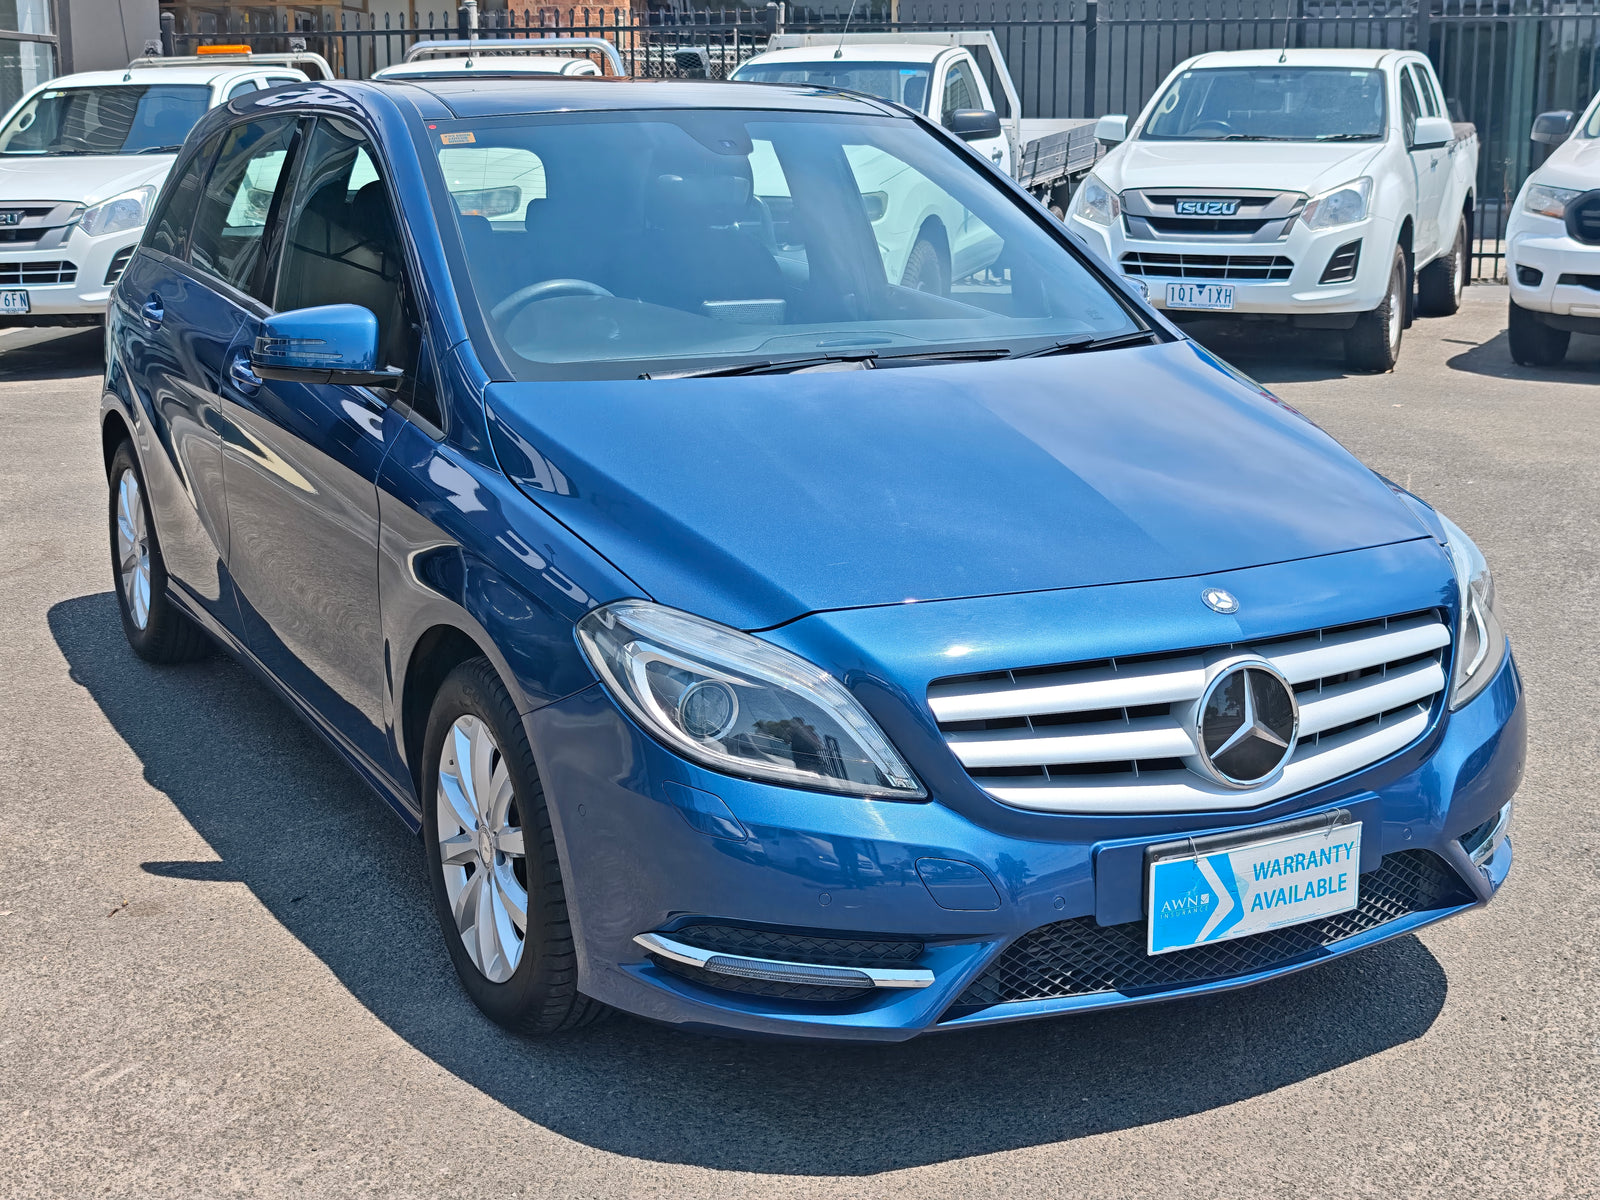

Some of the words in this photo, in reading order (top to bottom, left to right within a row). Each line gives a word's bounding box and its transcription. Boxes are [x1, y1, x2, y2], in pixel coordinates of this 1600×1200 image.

[1177, 202, 1236, 214] ISUZU
[4, 292, 27, 307] 6FN
[1170, 286, 1194, 302] 1QI
[1208, 287, 1232, 304] 1XH
[1253, 841, 1355, 881] WARRANTY
[1250, 872, 1348, 912] AVAILABLE
[1160, 894, 1199, 912] AWN
[1160, 904, 1209, 920] INSURANCE
